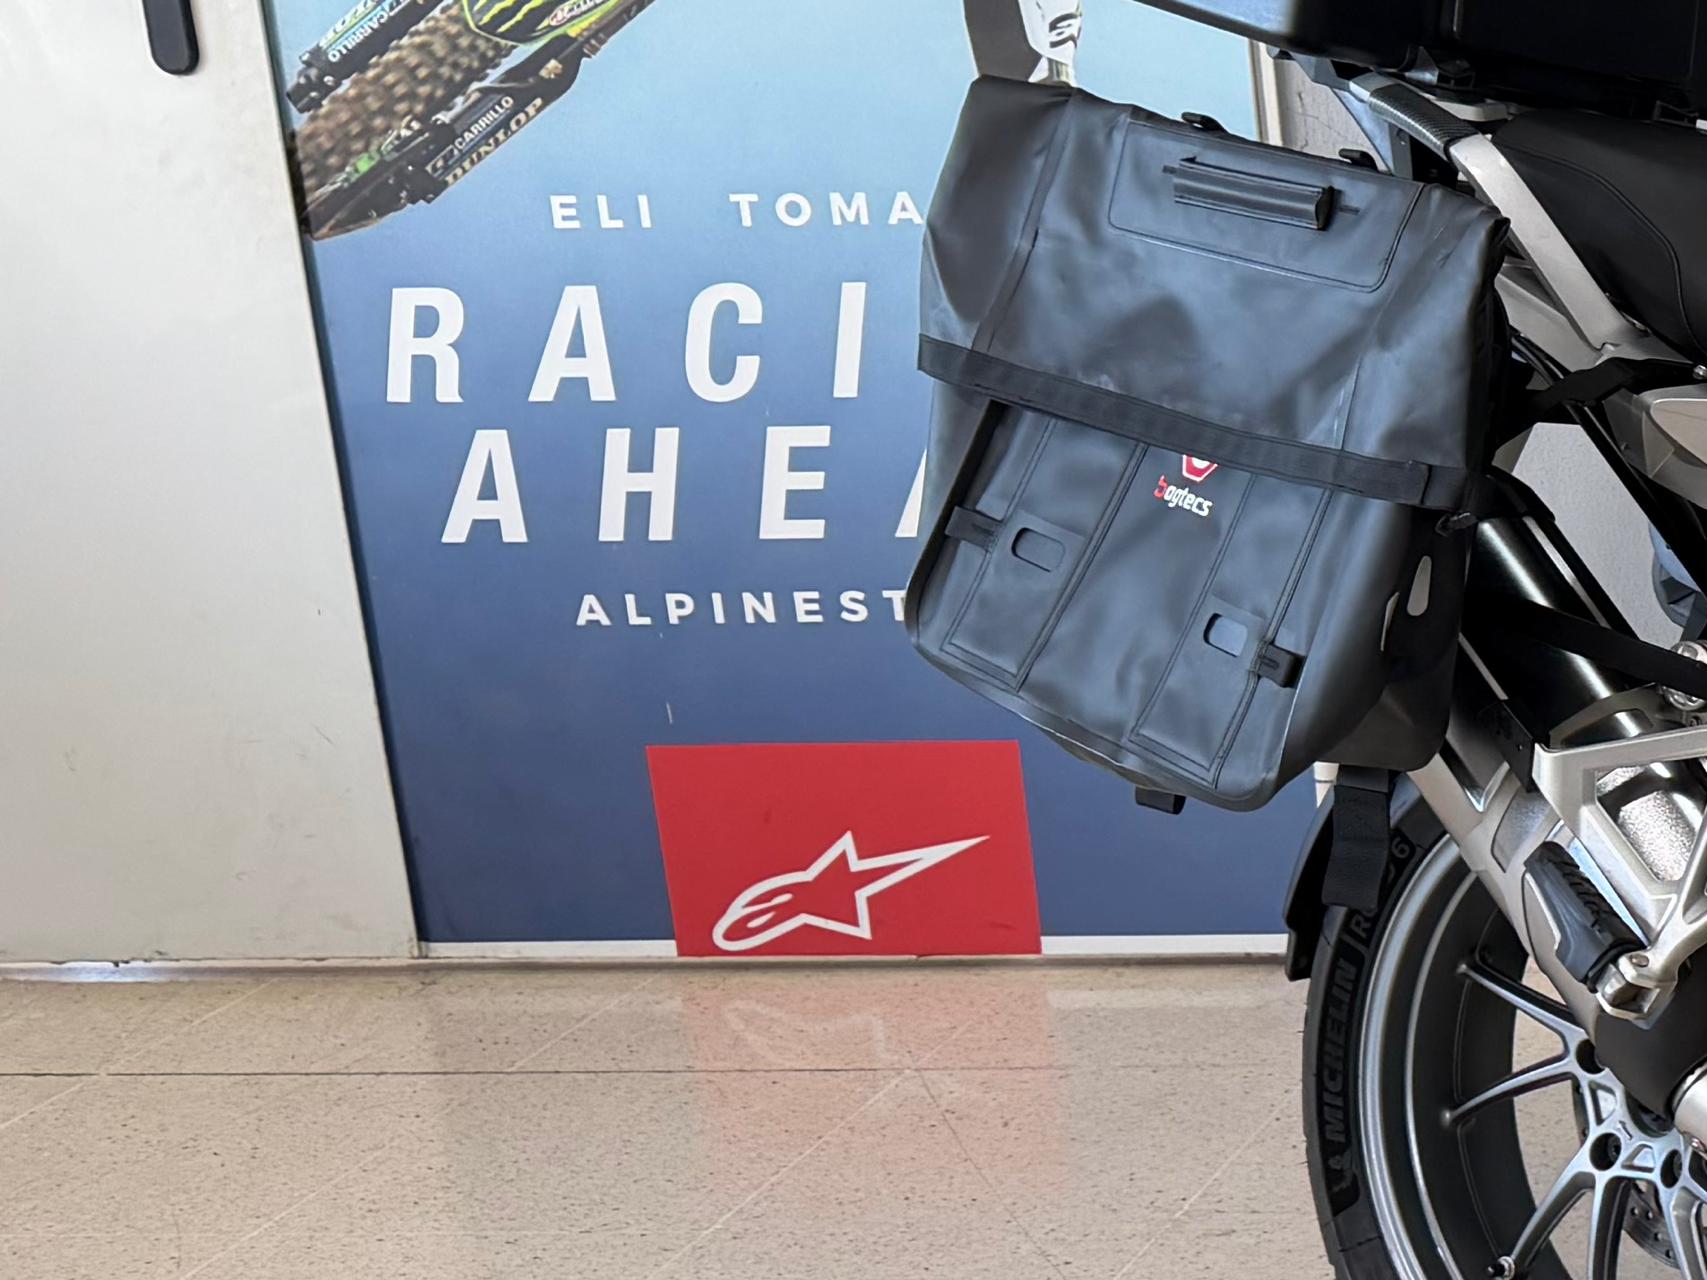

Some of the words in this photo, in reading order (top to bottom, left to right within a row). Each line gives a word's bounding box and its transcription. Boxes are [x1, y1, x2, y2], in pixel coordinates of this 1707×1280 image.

[327, 11, 389, 63] CARRILLO
[446, 97, 543, 187] DUNLOP
[454, 96, 514, 151] CARRILLO
[551, 194, 652, 229] ELI
[730, 191, 924, 227] TOMA
[386, 281, 867, 404] RACI
[1153, 475, 1213, 517] bagtecs
[576, 589, 906, 626] ALPINEST
[1322, 958, 1357, 1143] MICHELIN
